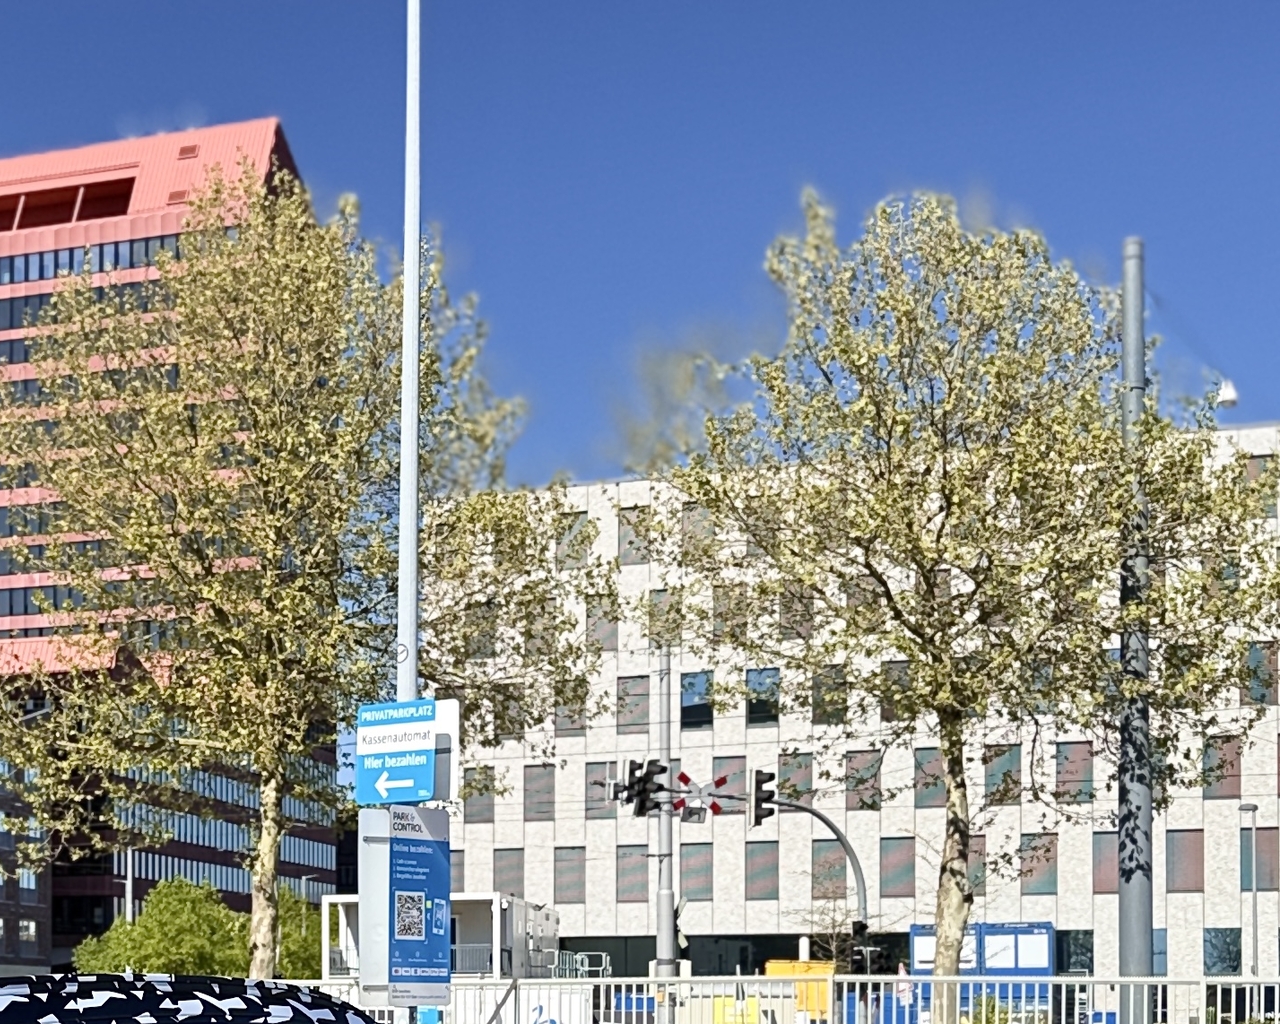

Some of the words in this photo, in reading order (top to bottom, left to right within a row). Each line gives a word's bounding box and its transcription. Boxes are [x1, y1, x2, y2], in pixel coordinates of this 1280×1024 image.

[361, 705, 433, 722] PRIVATPARKPLATZ
[362, 729, 431, 745] Kassenautomat
[364, 756, 384, 769] Hier
[384, 753, 427, 768] bezahlen
[393, 811, 410, 821] PARK
[392, 822, 423, 833] CONTROL
